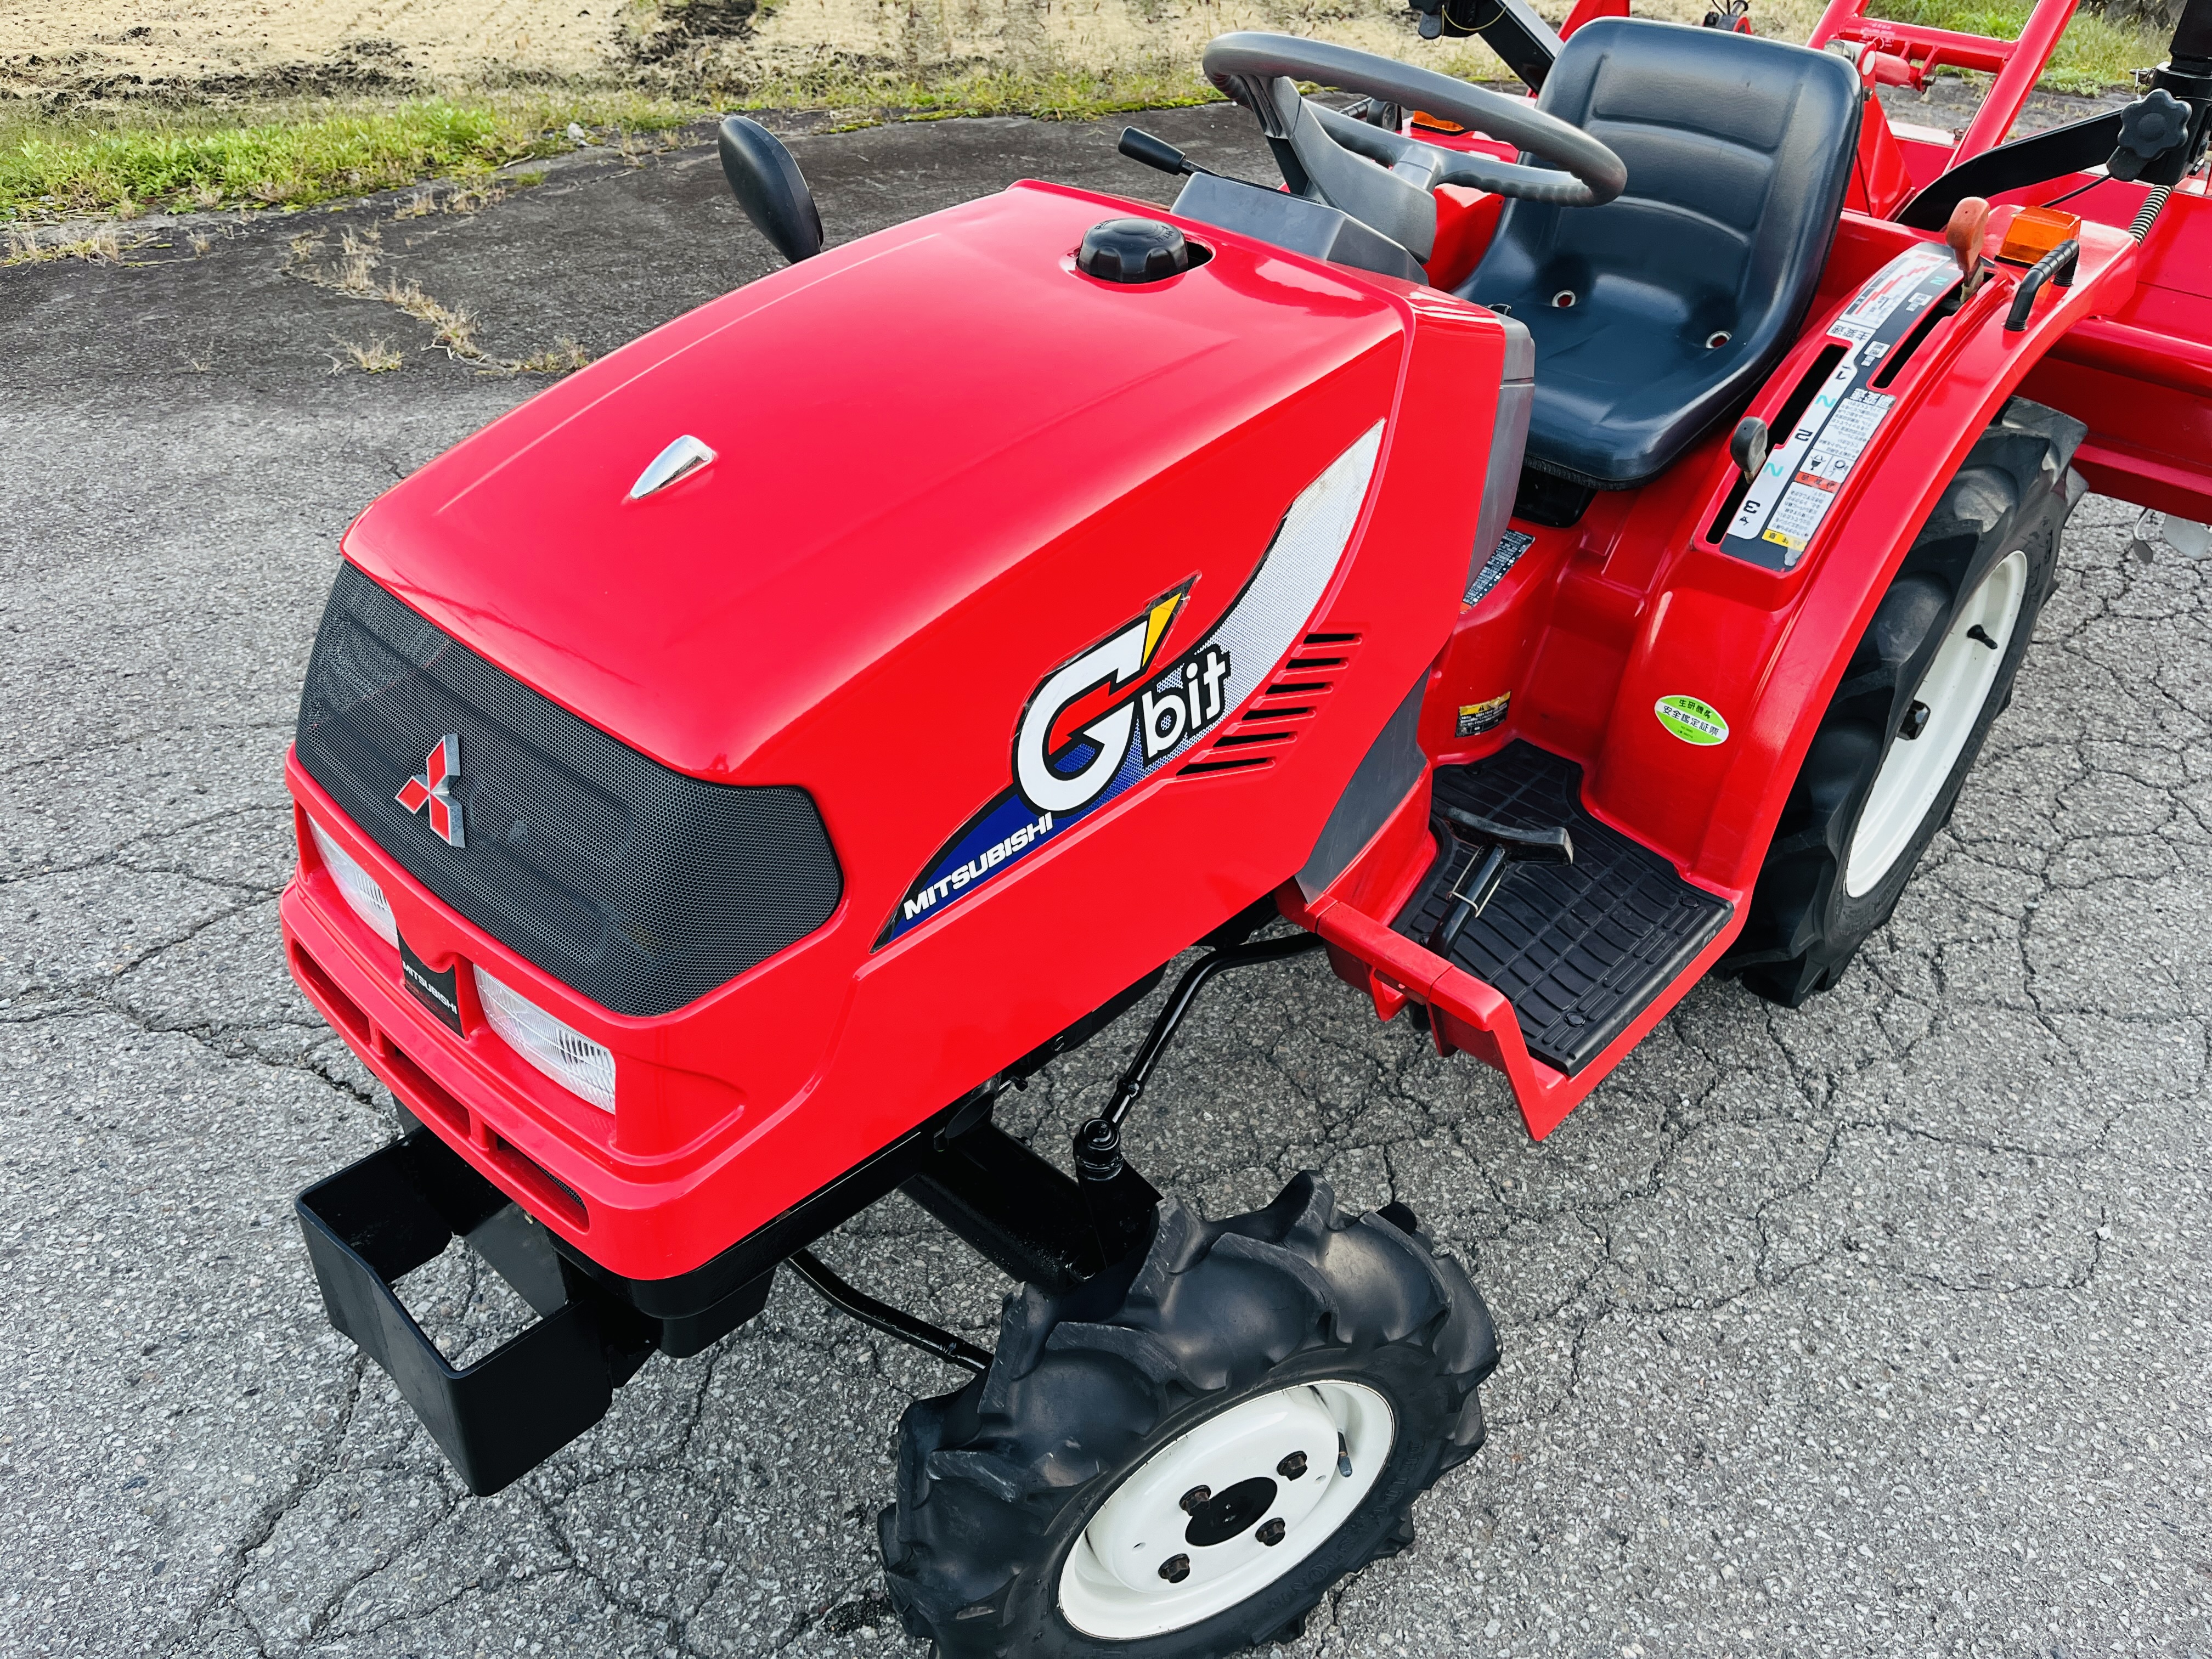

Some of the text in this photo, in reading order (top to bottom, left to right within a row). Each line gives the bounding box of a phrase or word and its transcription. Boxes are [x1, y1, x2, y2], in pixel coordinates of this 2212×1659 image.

[1831, 324, 1871, 341] 主変速
[1815, 394, 1837, 408] N
[1795, 428, 1813, 442] 2
[1762, 462, 1784, 477] N
[1743, 500, 1760, 514] 3
[1663, 706, 1719, 736] 安全鑑定証票
[904, 811, 1053, 920] MITSUBISHI
[402, 960, 458, 1014] MITSUBISHI
